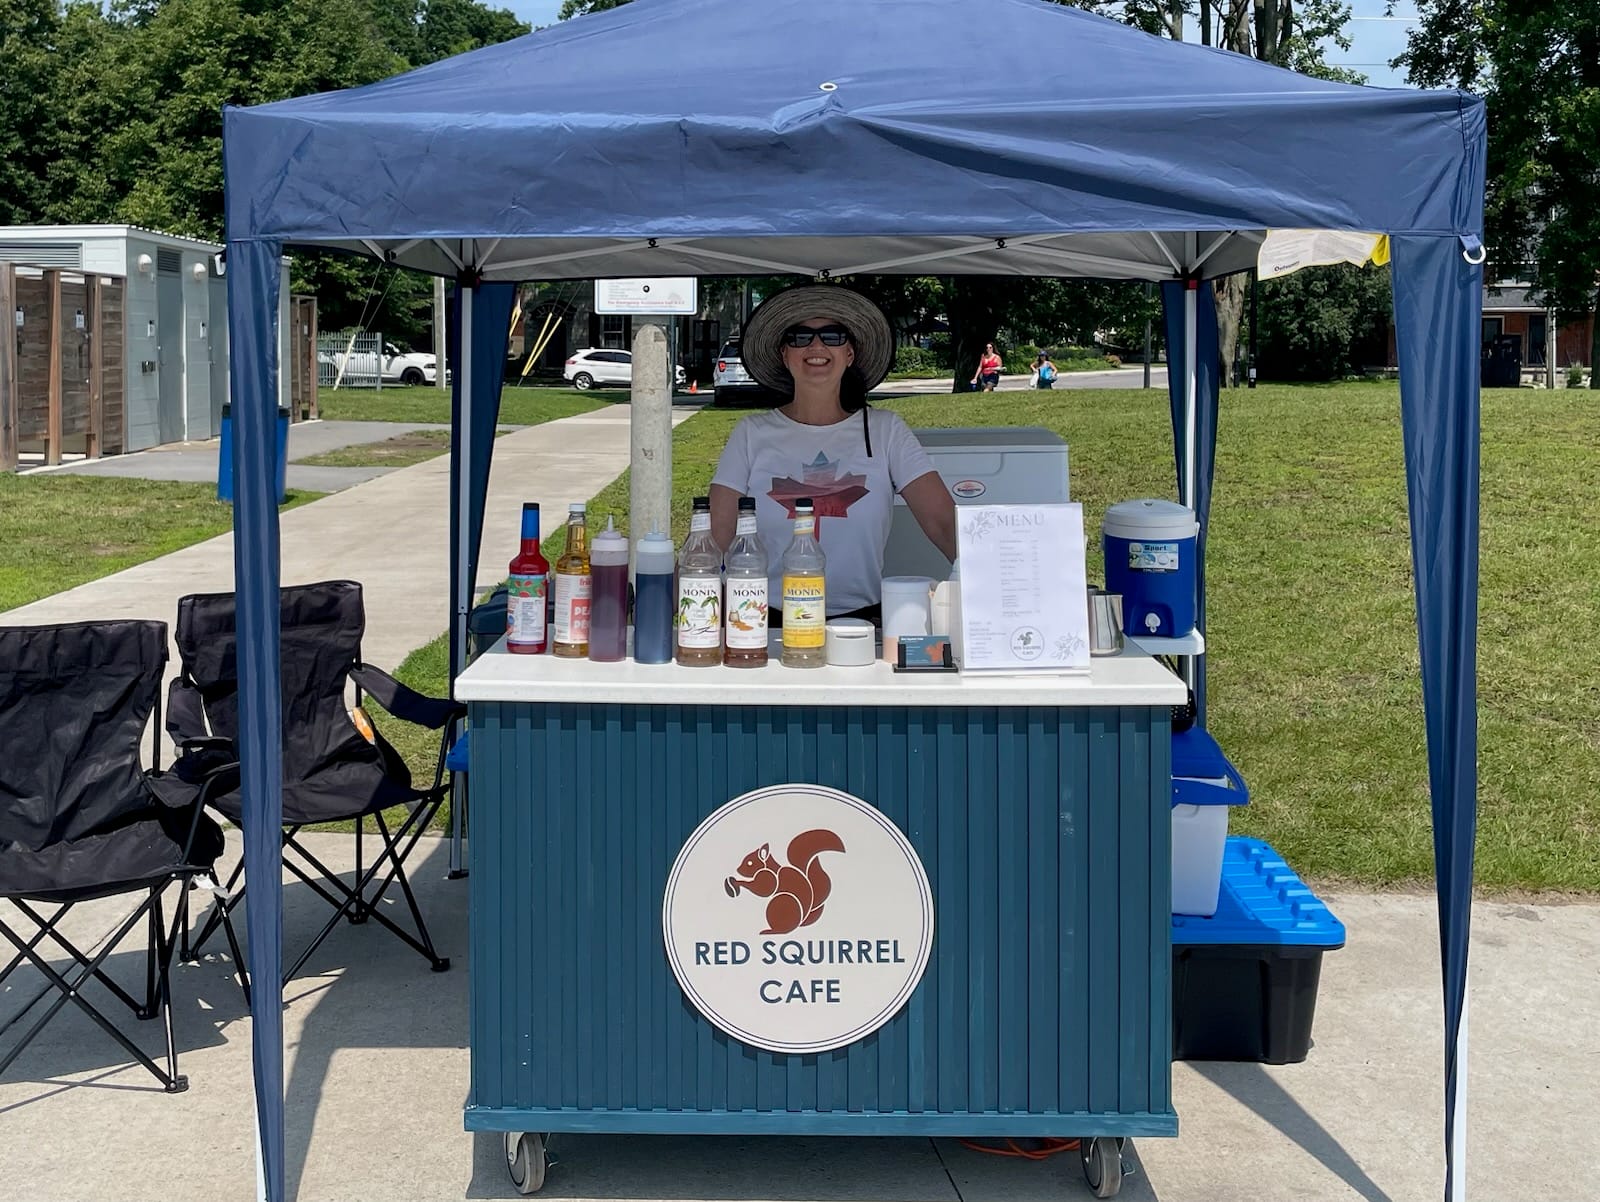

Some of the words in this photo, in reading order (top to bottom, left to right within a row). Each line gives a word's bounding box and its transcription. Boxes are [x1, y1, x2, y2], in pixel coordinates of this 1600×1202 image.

[997, 513, 1045, 526] MENU
[683, 588, 717, 596] MONIN
[733, 589, 765, 597] MONIN
[786, 588, 821, 596] MONIN
[695, 941, 750, 965] RED
[761, 940, 905, 965] SQUIRREL
[759, 979, 840, 1004] CAFE
